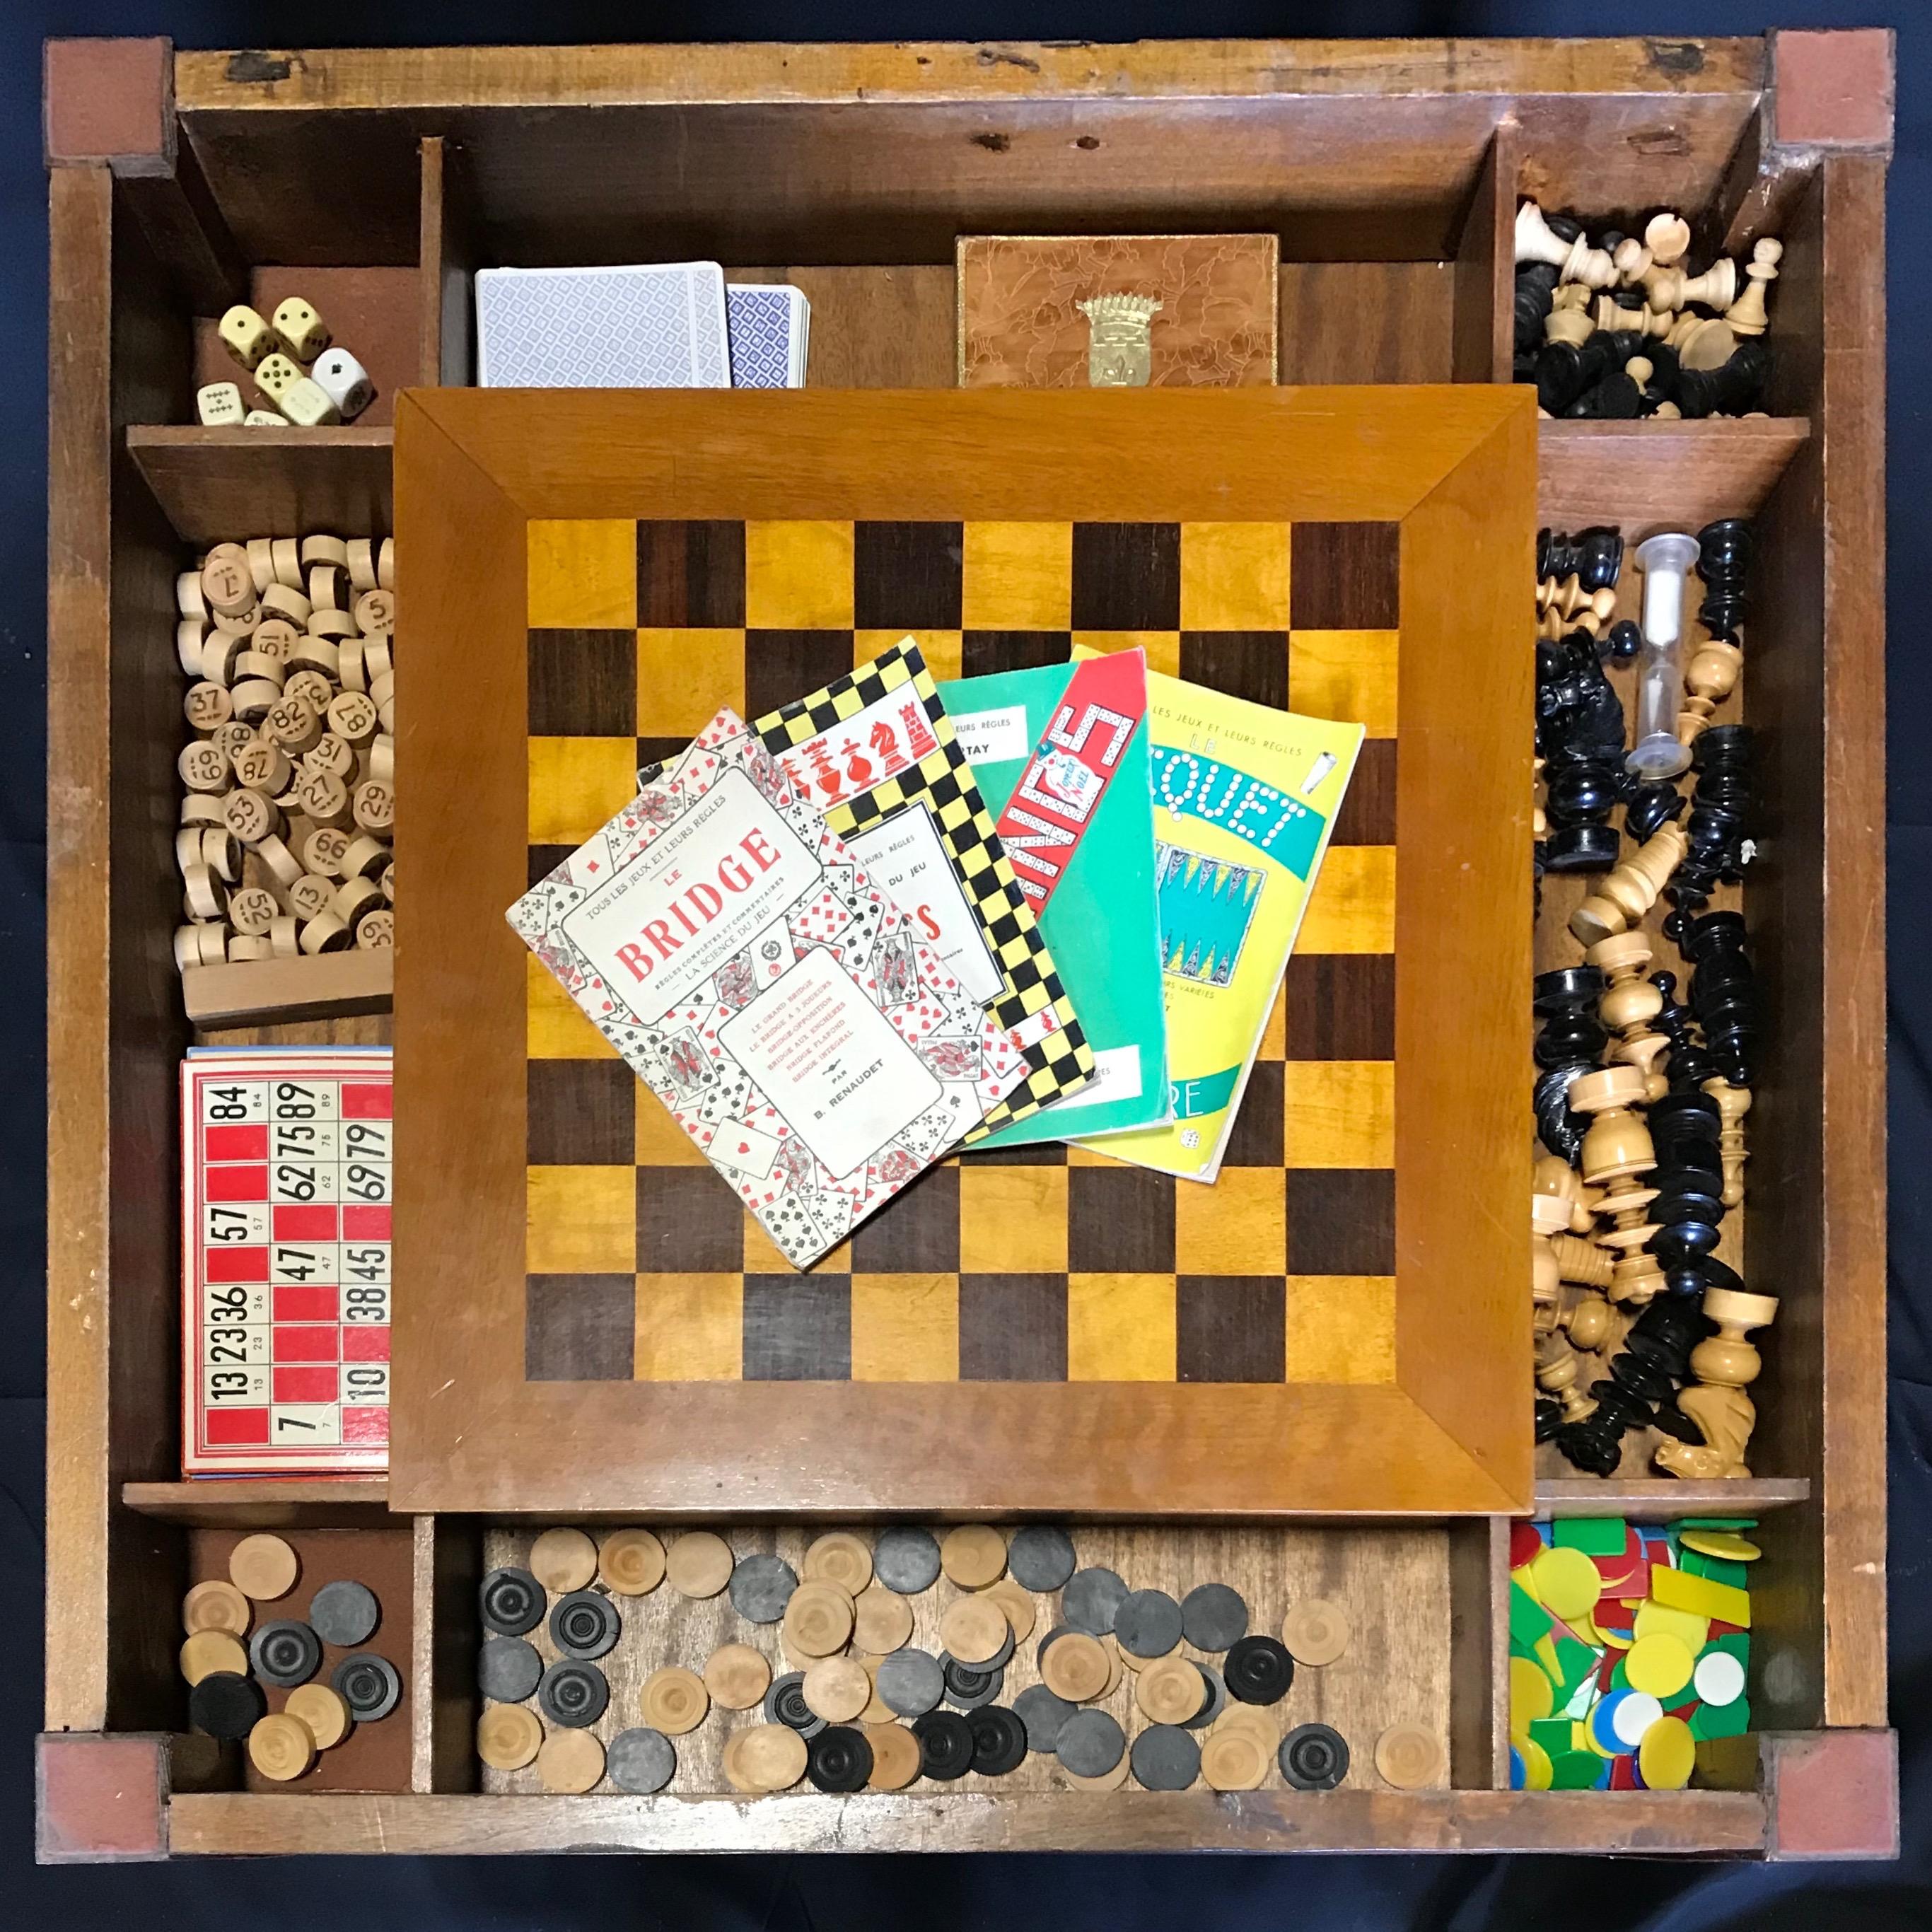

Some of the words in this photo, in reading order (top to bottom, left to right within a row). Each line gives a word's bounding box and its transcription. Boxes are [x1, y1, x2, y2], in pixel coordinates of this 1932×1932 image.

[369, 598, 386, 619] 5
[260, 635, 279, 656] 51
[190, 689, 219, 712] 37
[272, 702, 305, 729] 82
[337, 704, 366, 733] 87
[1153, 706, 1170, 718] LES
[1176, 714, 1202, 728] JEUX
[1207, 723, 1219, 733] ET
[1225, 729, 1256, 745] LEURS
[199, 750, 221, 779] 69
[318, 737, 342, 762] 31
[962, 743, 989, 756] TAY
[244, 759, 267, 781] 78
[303, 774, 330, 805] 27
[361, 786, 385, 816] 29
[1151, 746, 1307, 847] QUET
[227, 796, 255, 830] 53
[316, 833, 347, 859] 66
[861, 851, 884, 867] LEURS
[586, 897, 611, 919] TOUS
[610, 883, 628, 900] LES
[628, 863, 651, 886] JEUX
[651, 851, 664, 865] ET
[664, 826, 694, 854] LEURS
[663, 869, 682, 887] LE
[888, 874, 903, 886] DU
[910, 862, 926, 877] JEU
[248, 894, 272, 924] 52
[296, 887, 318, 909] 13
[614, 827, 781, 983] BRIDGE
[722, 924, 732, 934] ET
[732, 876, 784, 925] COMMENTAIRES
[685, 968, 701, 980] LA
[700, 935, 738, 968] SCIENCE
[737, 921, 752, 937] DU
[754, 905, 770, 924] JEU
[749, 1042, 760, 1052] LE
[760, 1019, 786, 1042] BRIDGE
[801, 980, 832, 1008] JOUEURS
[751, 1023, 762, 1034] LE
[762, 1002, 786, 1024] GRAND
[787, 979, 813, 1003] BRIDGE
[767, 1047, 793, 1071] BRIDGE
[794, 1035, 809, 1048] AUX
[786, 1047, 813, 1071] BRIDGE
[813, 1020, 846, 1048] PLAFOND
[792, 1059, 818, 1083] BRIDGE
[832, 1070, 847, 1084] PAR
[209, 1087, 247, 1119] 84
[253, 1093, 262, 1107] 84
[277, 1083, 315, 1119] 89
[322, 1093, 330, 1107] 89
[813, 1110, 825, 1119] B.
[829, 1059, 883, 1107] RENAUDET
[277, 1126, 315, 1157] 75
[322, 1134, 331, 1146] 75
[347, 1124, 385, 1158] 79
[277, 1165, 315, 1201] 62
[322, 1175, 331, 1189] 62
[347, 1165, 385, 1200] 69
[211, 1208, 248, 1240] 57
[253, 1217, 262, 1230] 57
[276, 1248, 315, 1281] 47
[322, 1256, 331, 1269] 47
[346, 1249, 385, 1281] 45
[211, 1287, 248, 1322] 36
[254, 1295, 263, 1309] 36
[347, 1288, 386, 1320] 38
[210, 1328, 247, 1363] 23
[253, 1337, 262, 1350] 23
[211, 1373, 248, 1400] 13
[254, 1378, 263, 1390] 13
[347, 1369, 386, 1401] 10
[279, 1417, 316, 1431] 7
